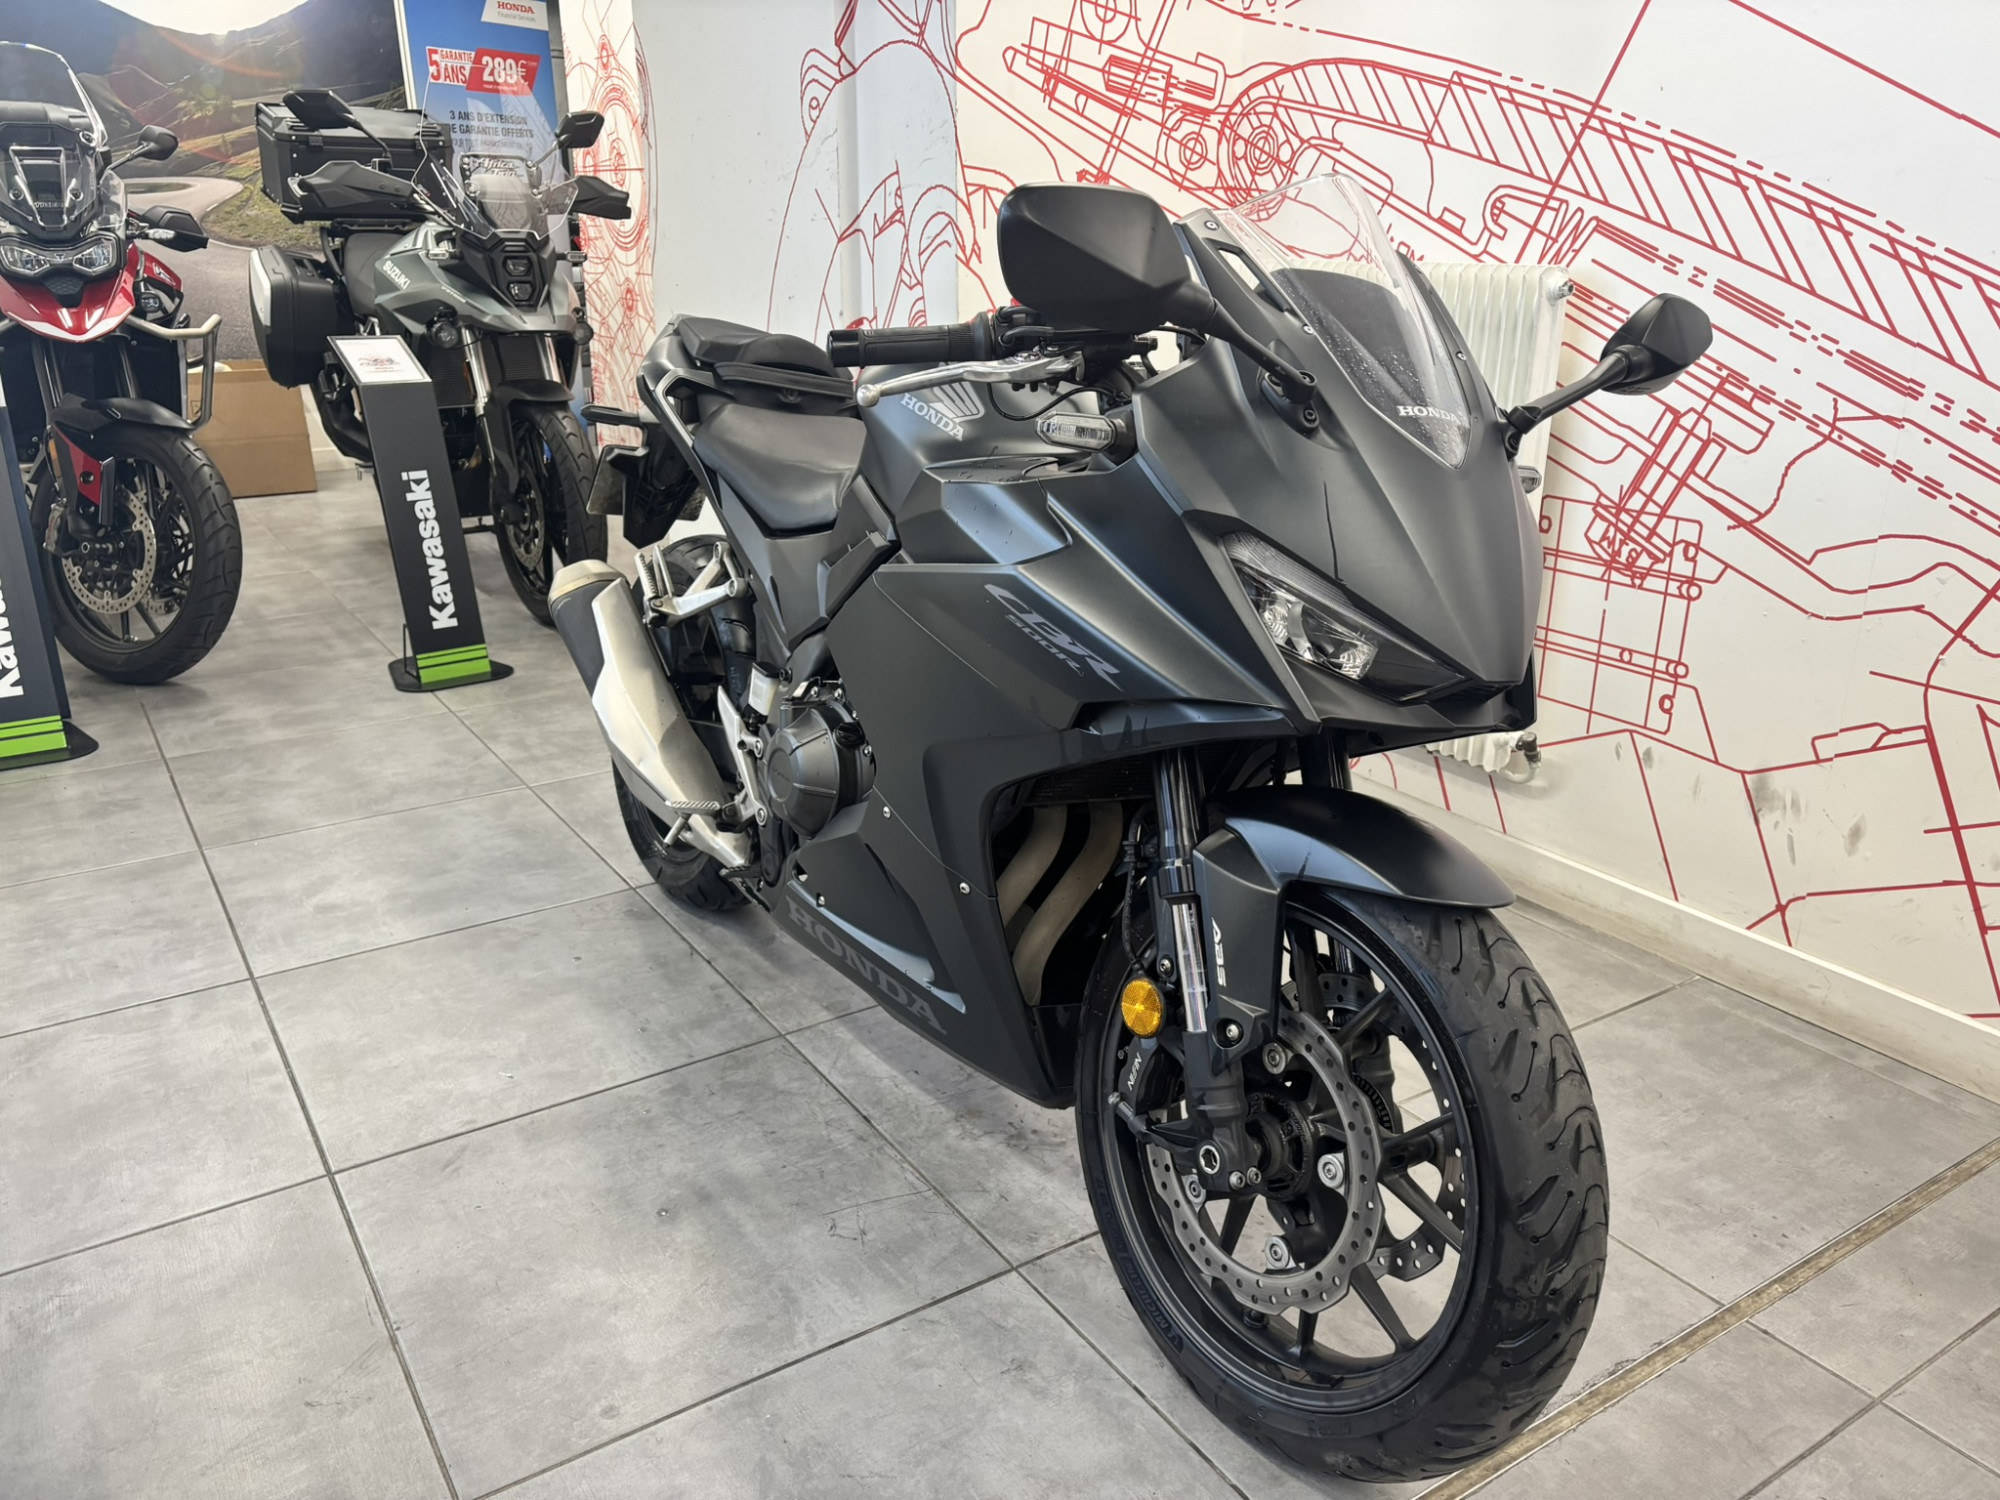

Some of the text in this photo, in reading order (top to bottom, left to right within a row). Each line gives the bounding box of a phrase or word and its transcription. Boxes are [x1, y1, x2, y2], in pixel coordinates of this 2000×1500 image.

[496, 1, 535, 14] HONDA
[427, 48, 467, 84] 5 ANS
[440, 49, 473, 63] GARANTIE
[449, 110, 528, 125] 3 ANS D'EXTENSION
[460, 124, 499, 136] GARANTIE
[501, 127, 534, 138] OFFERTS
[382, 260, 411, 290] SUZUKI
[900, 392, 966, 442] HONDA
[1396, 405, 1461, 424] HONDA
[401, 470, 458, 630] Kawasaki
[984, 584, 1125, 692] CBR
[785, 895, 948, 1036] HONDA
[1211, 917, 1227, 987] ABS
